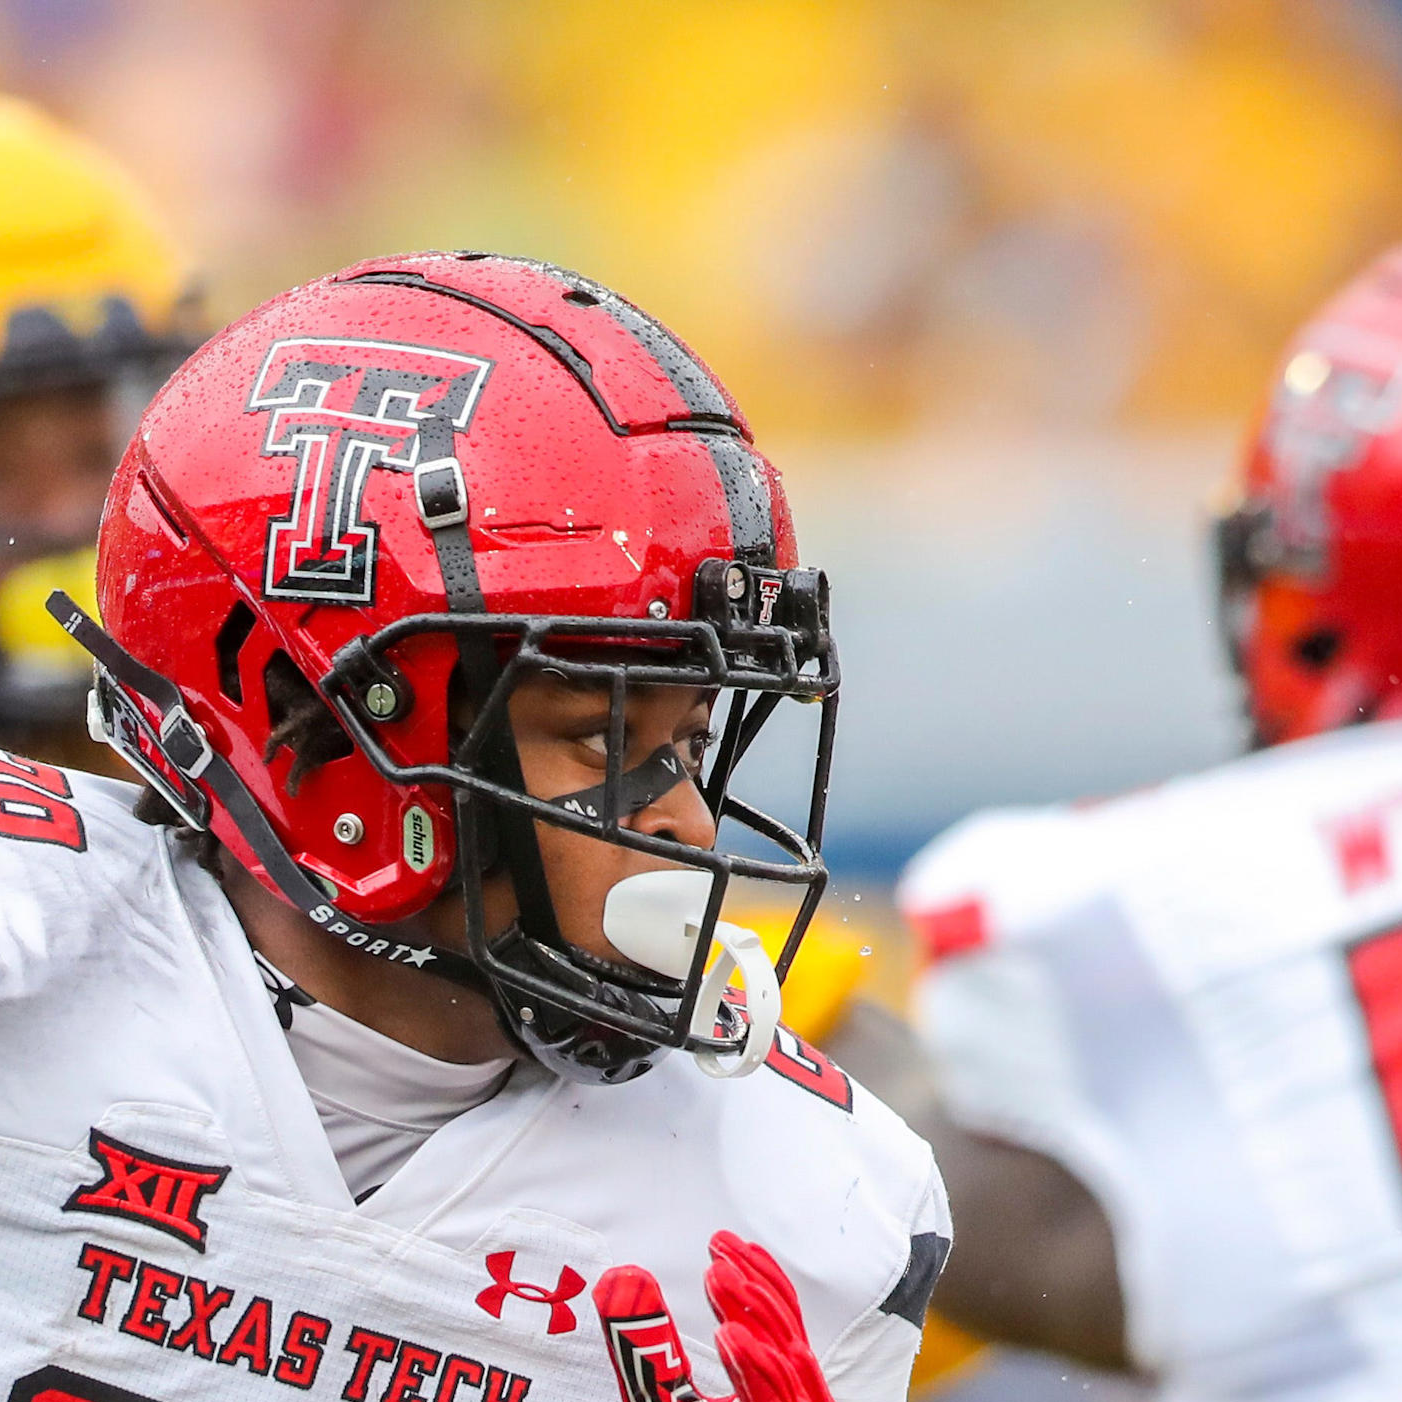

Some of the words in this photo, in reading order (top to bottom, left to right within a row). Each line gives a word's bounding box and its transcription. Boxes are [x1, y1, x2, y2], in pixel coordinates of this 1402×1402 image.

[412, 813, 427, 865] schutt
[309, 905, 411, 960] SPORT
[77, 1242, 332, 1390] TEXAS
